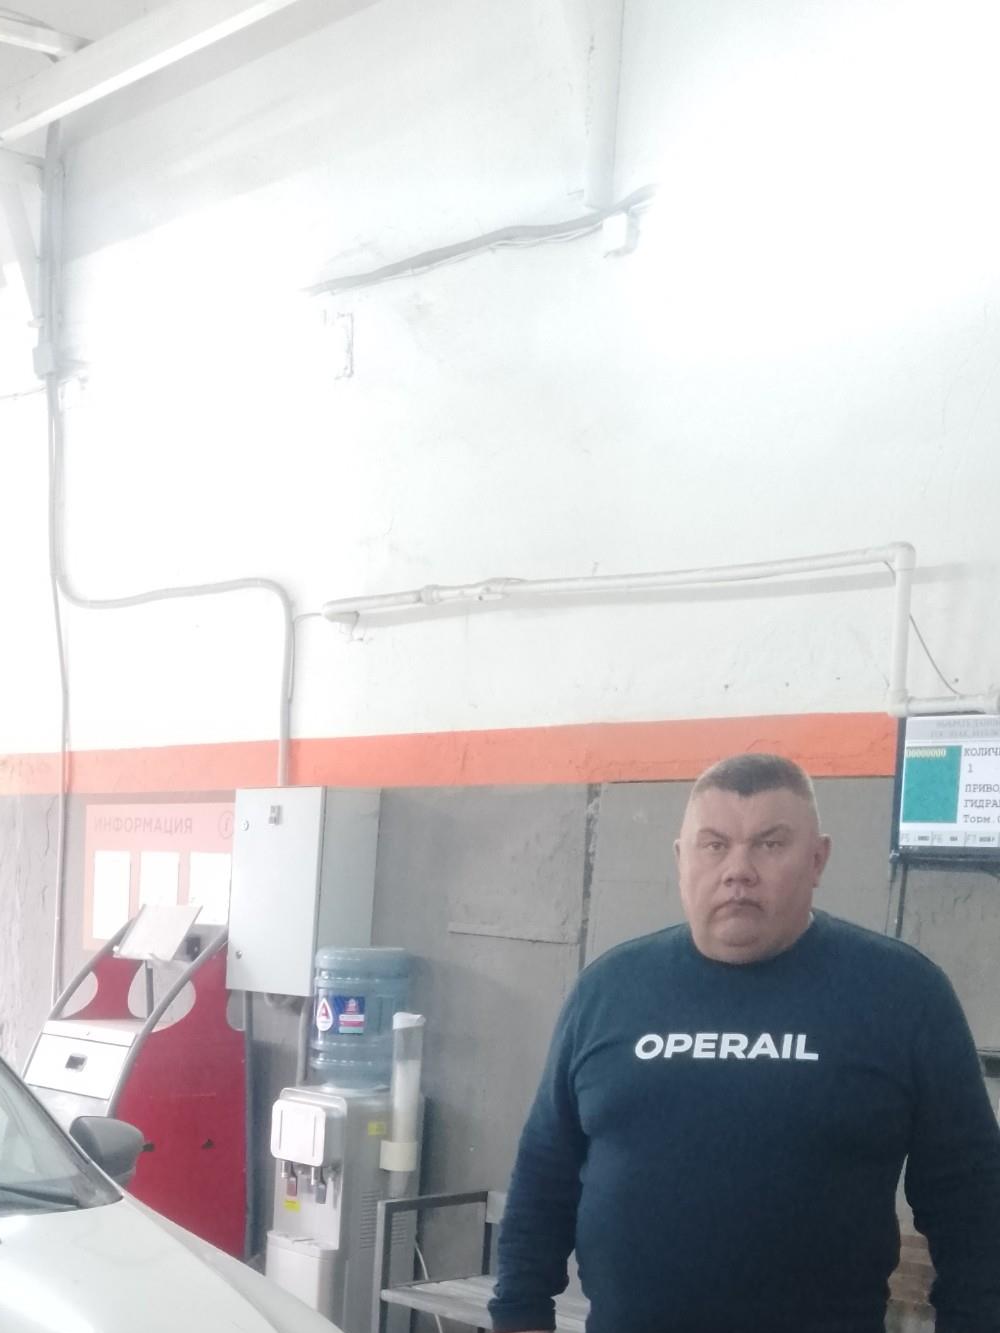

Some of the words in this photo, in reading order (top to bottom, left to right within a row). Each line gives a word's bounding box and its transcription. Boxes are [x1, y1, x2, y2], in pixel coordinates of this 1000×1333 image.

[963, 746, 1000, 758] КОЛИЧ
[965, 783, 1000, 794] ПРИВО
[94, 815, 193, 836] ИНФОРМАЦИЯ
[634, 1032, 819, 1061] OPERAIL
